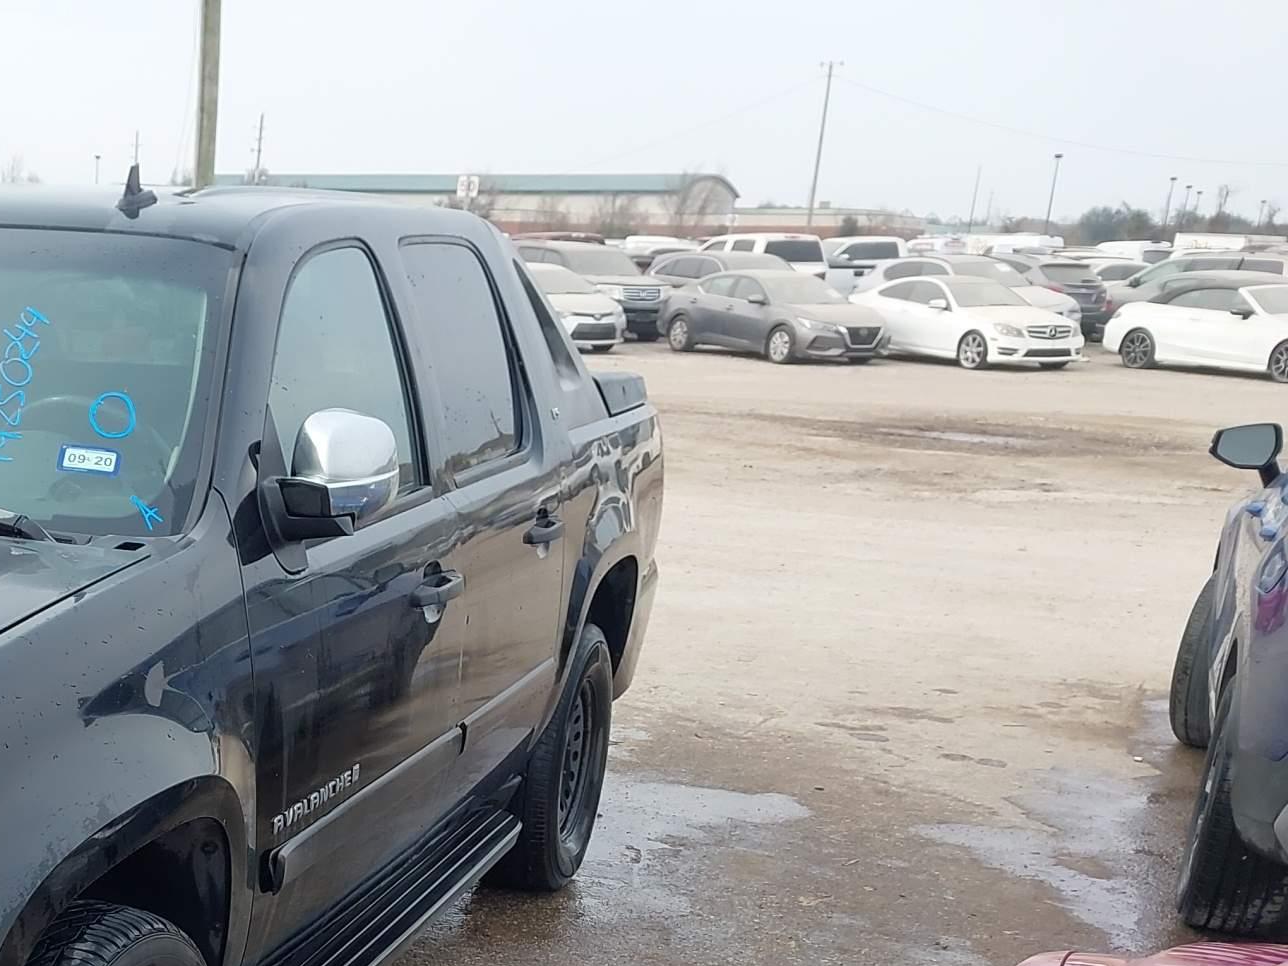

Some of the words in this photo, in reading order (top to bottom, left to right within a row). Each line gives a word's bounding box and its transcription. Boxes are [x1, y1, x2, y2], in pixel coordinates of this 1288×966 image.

[67, 453, 86, 465] 09
[94, 455, 113, 468] 20
[272, 770, 352, 835] AVALANCHE
